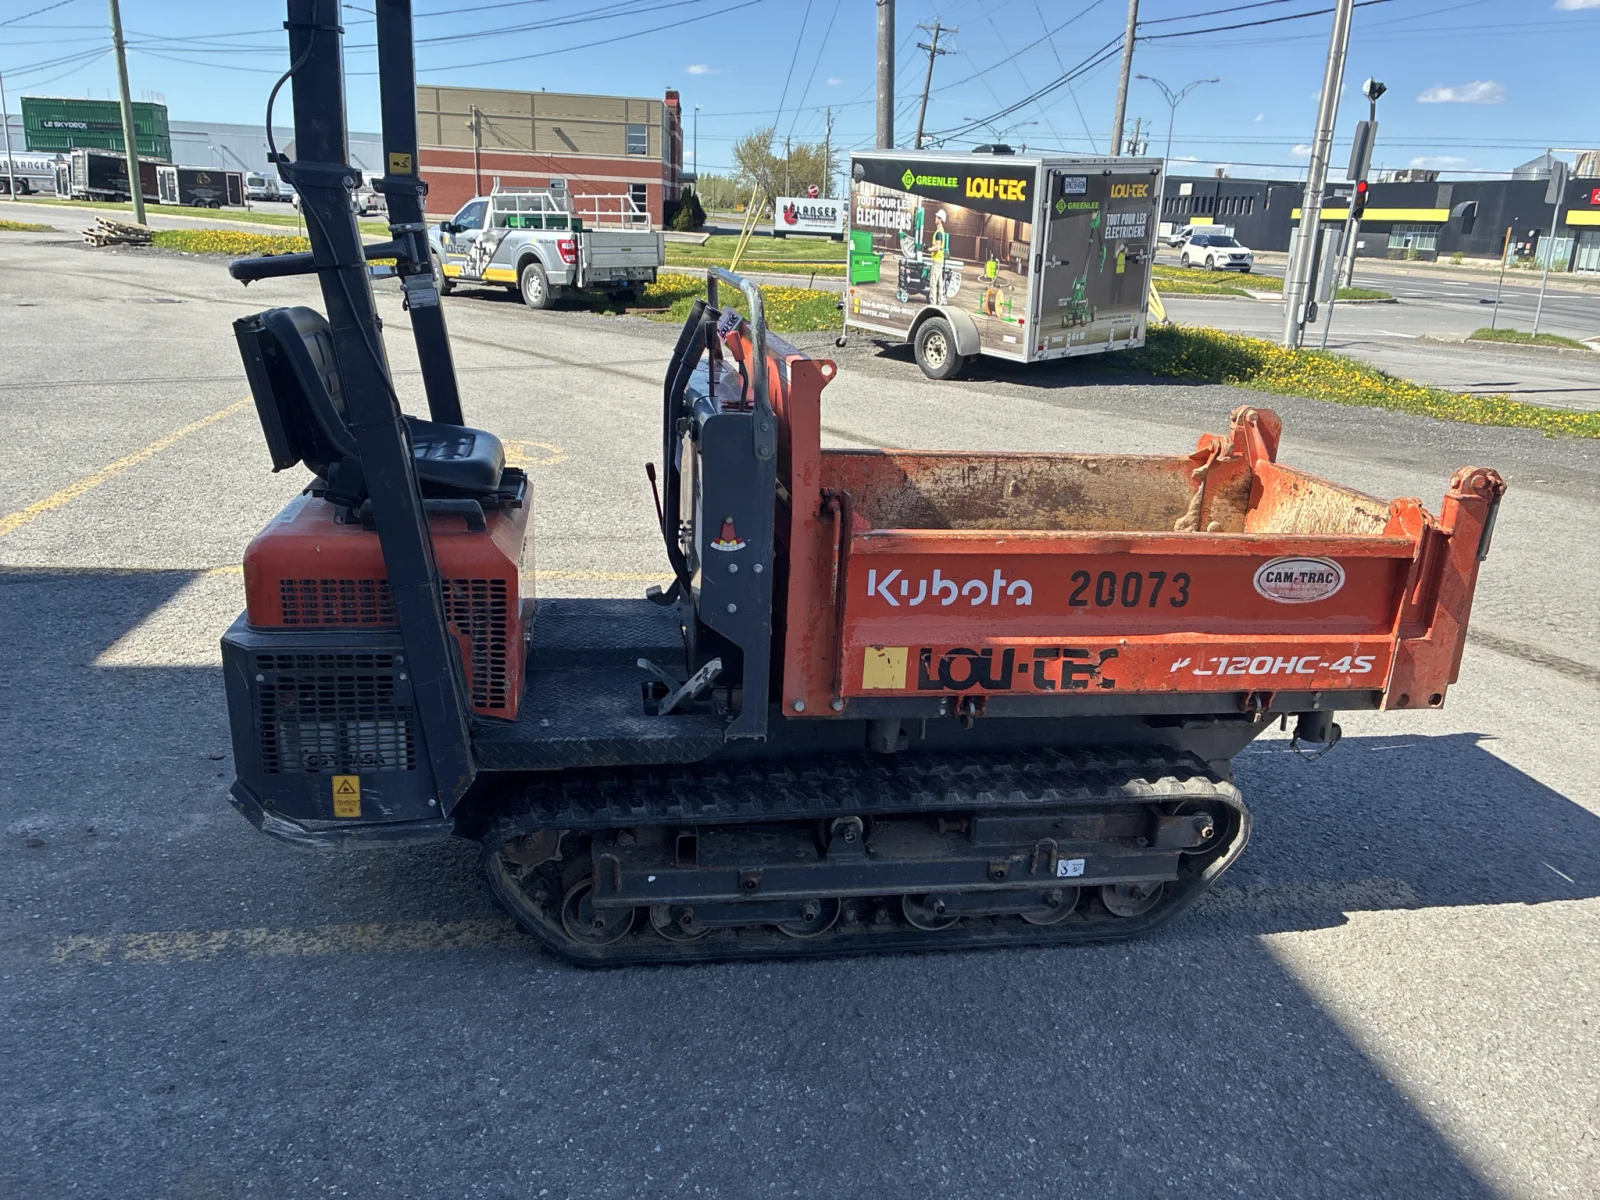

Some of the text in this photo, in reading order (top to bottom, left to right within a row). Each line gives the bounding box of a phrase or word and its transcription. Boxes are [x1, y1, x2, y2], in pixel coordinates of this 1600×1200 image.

[54, 121, 88, 129] SKYDECK
[916, 175, 958, 187] GREENLEE
[966, 177, 1026, 201] LOU-TEC
[1111, 184, 1149, 198] LOU-TEC
[857, 195, 911, 209] TOUT POUR LES
[1067, 202, 1099, 210] GREENLEE
[857, 205, 911, 230] ÉLECTRICIENS
[1107, 212, 1147, 225] TOUT POUR LES
[1105, 224, 1145, 239] ÉLECTRICIENS
[1265, 571, 1334, 584] CAM-TRAC
[867, 569, 1033, 606] Kubota
[1068, 570, 1191, 608] 20073
